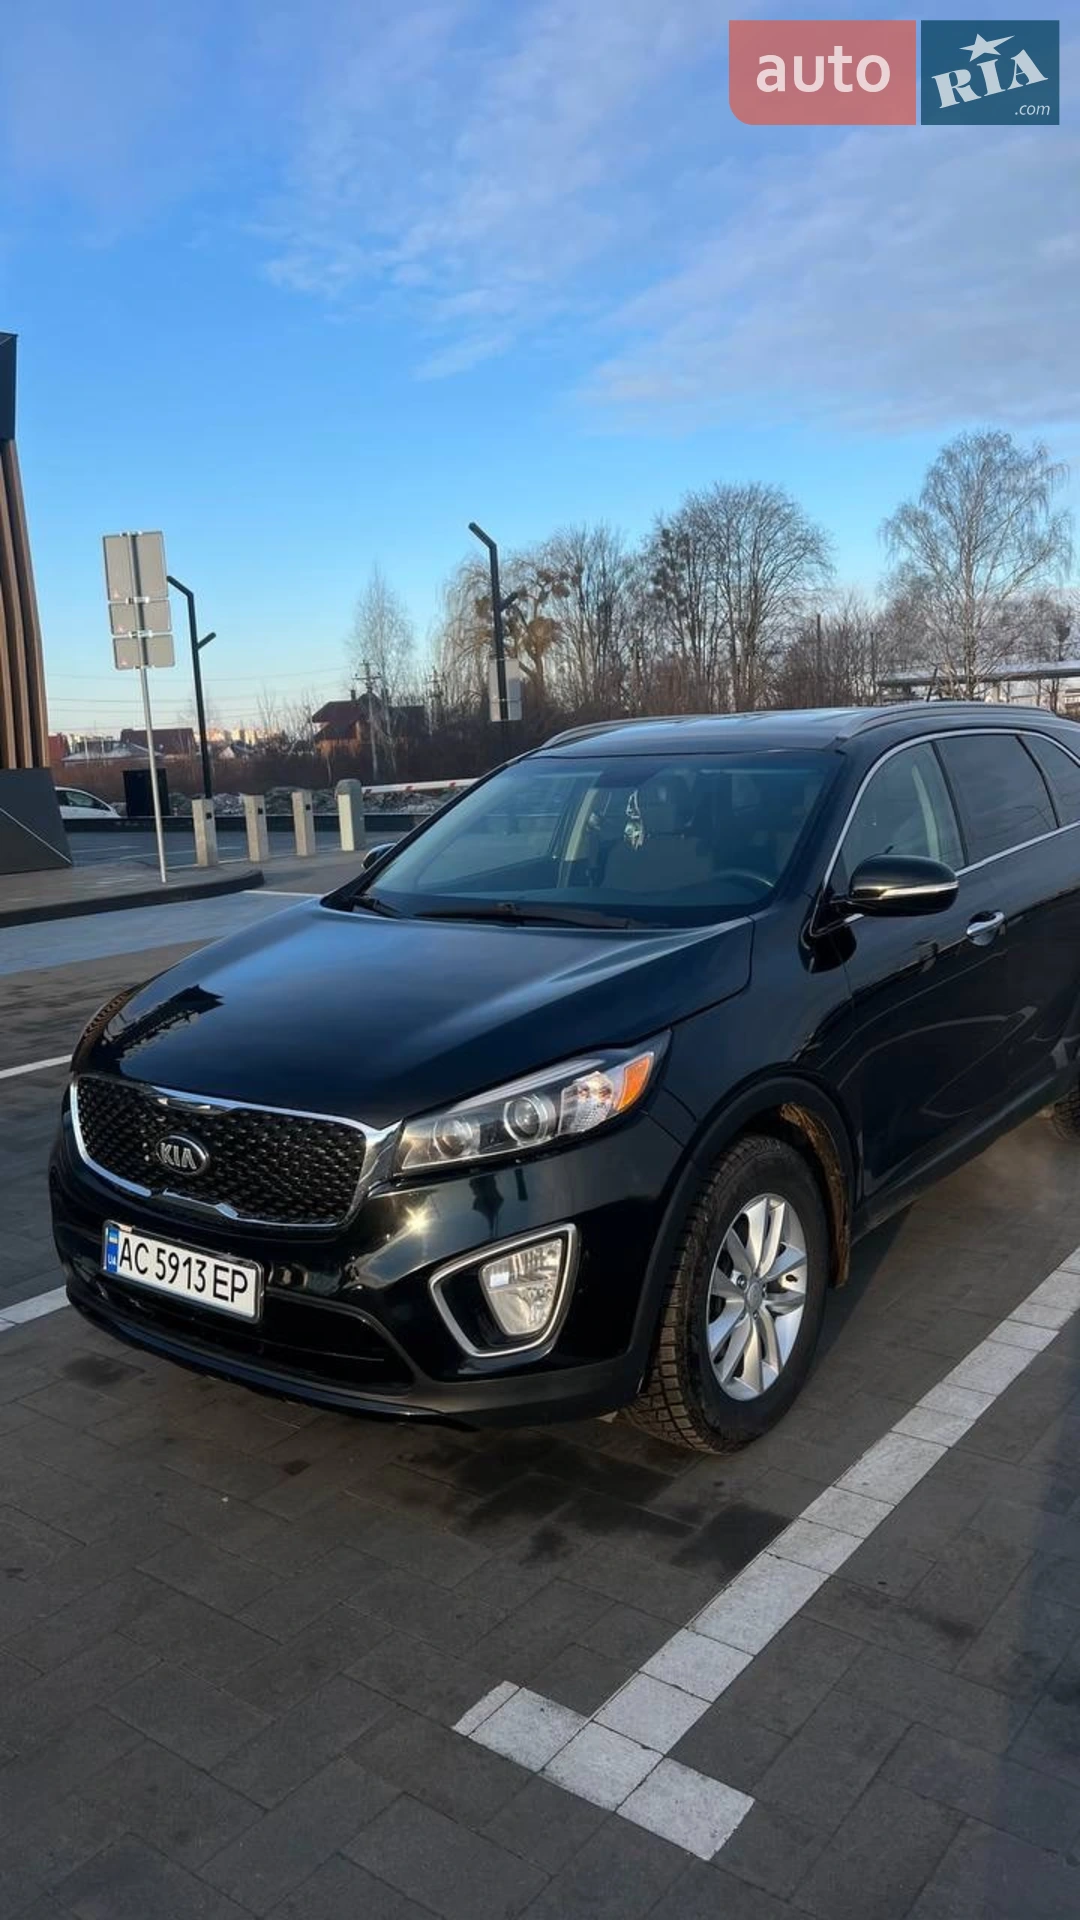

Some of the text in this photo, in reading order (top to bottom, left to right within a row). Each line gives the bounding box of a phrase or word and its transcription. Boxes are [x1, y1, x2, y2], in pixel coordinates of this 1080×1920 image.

[160, 1143, 197, 1170] KIA
[107, 1254, 117, 1266] UA
[119, 1237, 248, 1303] AC 5913 EP
